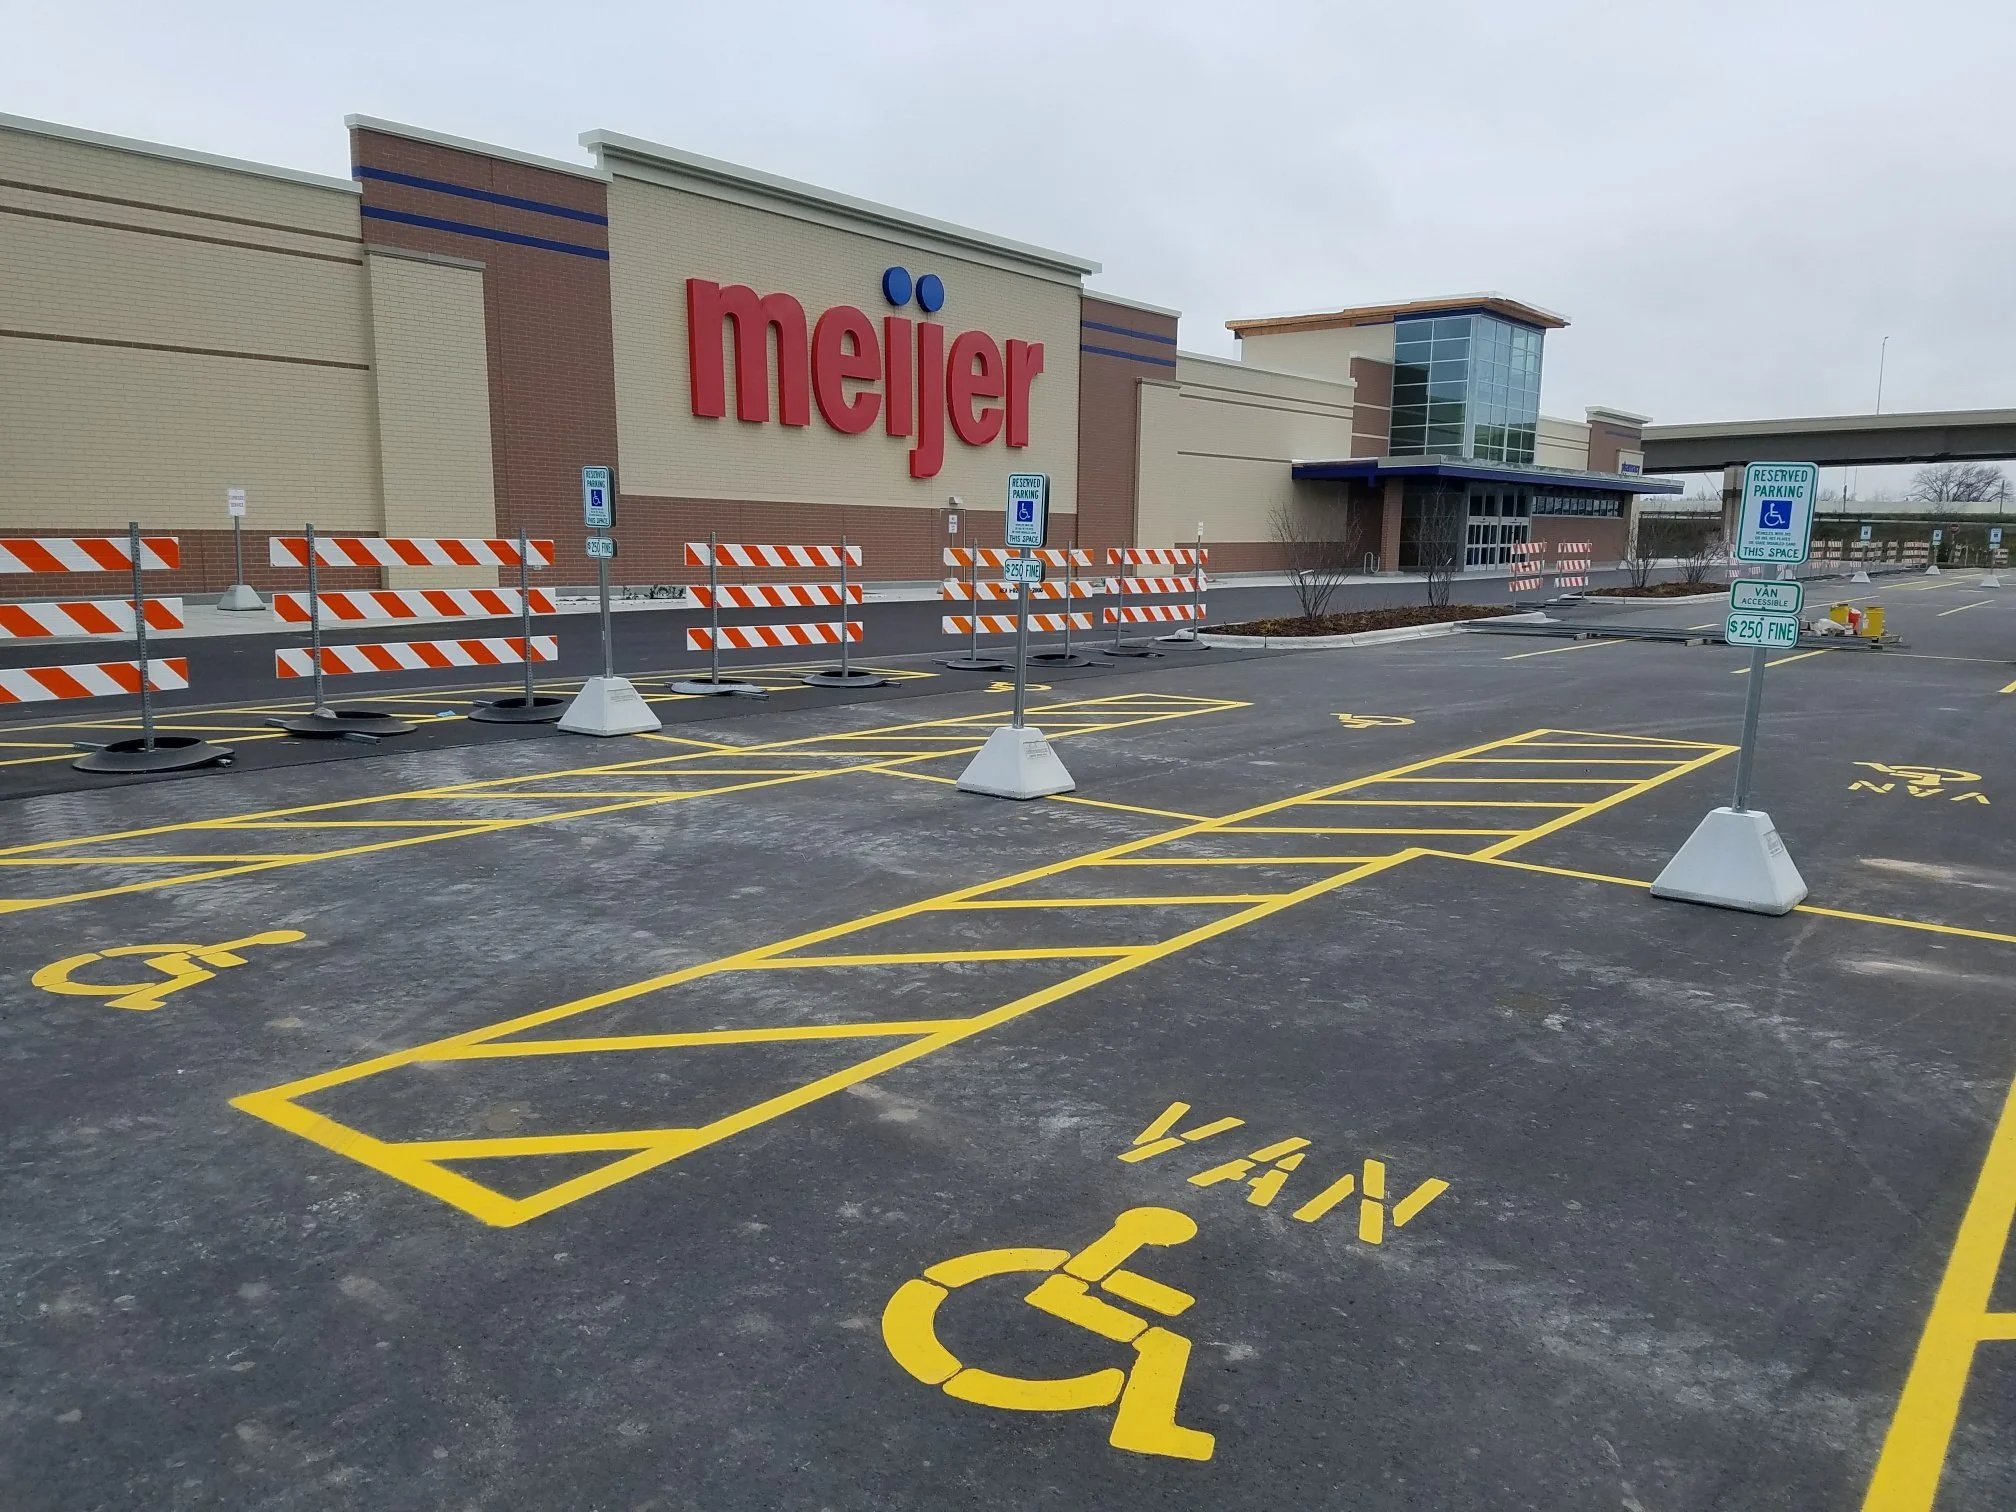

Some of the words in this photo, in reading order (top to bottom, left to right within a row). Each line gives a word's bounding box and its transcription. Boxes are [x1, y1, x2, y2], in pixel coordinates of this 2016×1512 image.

[686, 266, 1044, 478] meijer
[1753, 469, 1808, 483] RESERVED
[1012, 478, 1040, 488] RESERVED
[1013, 489, 1039, 500] PARKING
[1754, 485, 1804, 499] PARKING
[1022, 536, 1039, 544] SPACE
[1743, 546, 1765, 557] THIS
[1769, 548, 1800, 559] SPACE
[1006, 563, 1023, 577] $250
[1025, 565, 1039, 578] FINE
[1755, 587, 1778, 598] VAN
[1741, 598, 1789, 608] ACCESSIBLE
[1729, 619, 1763, 639] $250
[1767, 622, 1795, 641] FINE
[1117, 1101, 1450, 1245] VAN
